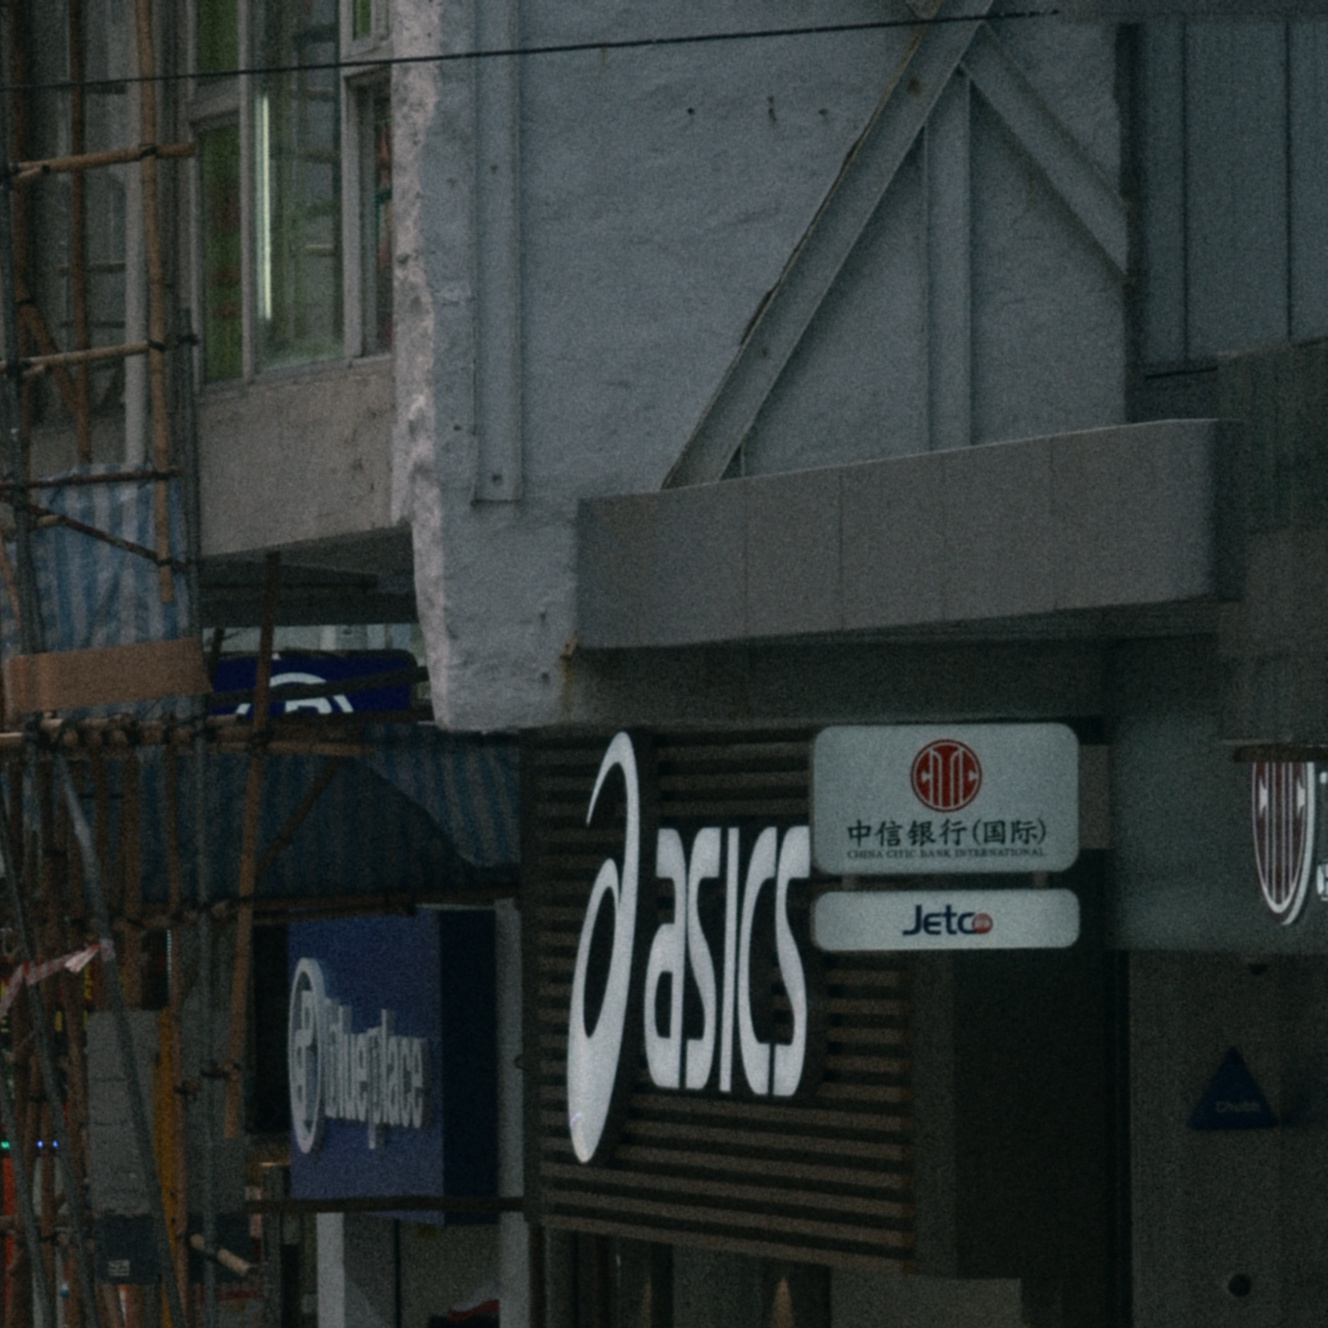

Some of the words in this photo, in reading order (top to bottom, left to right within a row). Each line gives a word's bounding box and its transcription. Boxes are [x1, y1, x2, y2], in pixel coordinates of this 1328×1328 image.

[846, 817, 1047, 848] 中信银行(国际)
[644, 825, 811, 1098] asics
